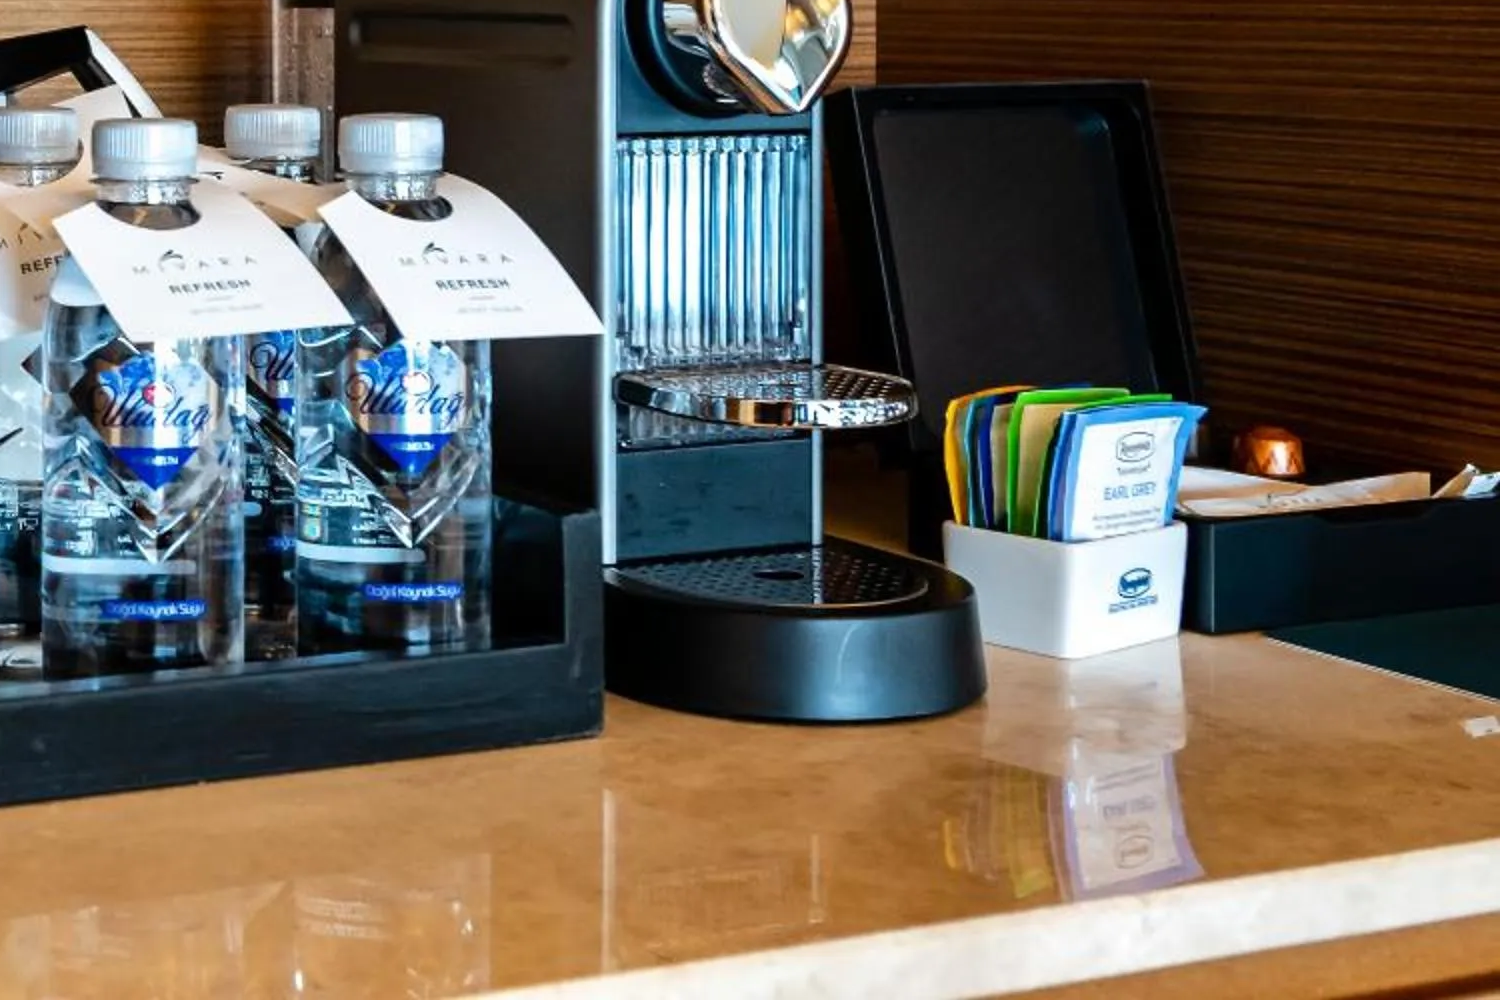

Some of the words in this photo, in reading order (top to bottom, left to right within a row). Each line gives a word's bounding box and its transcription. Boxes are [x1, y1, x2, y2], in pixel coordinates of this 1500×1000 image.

[168, 278, 252, 296] REFRESH
[435, 277, 511, 291] REFRESH
[1103, 484, 1130, 501] EARL
